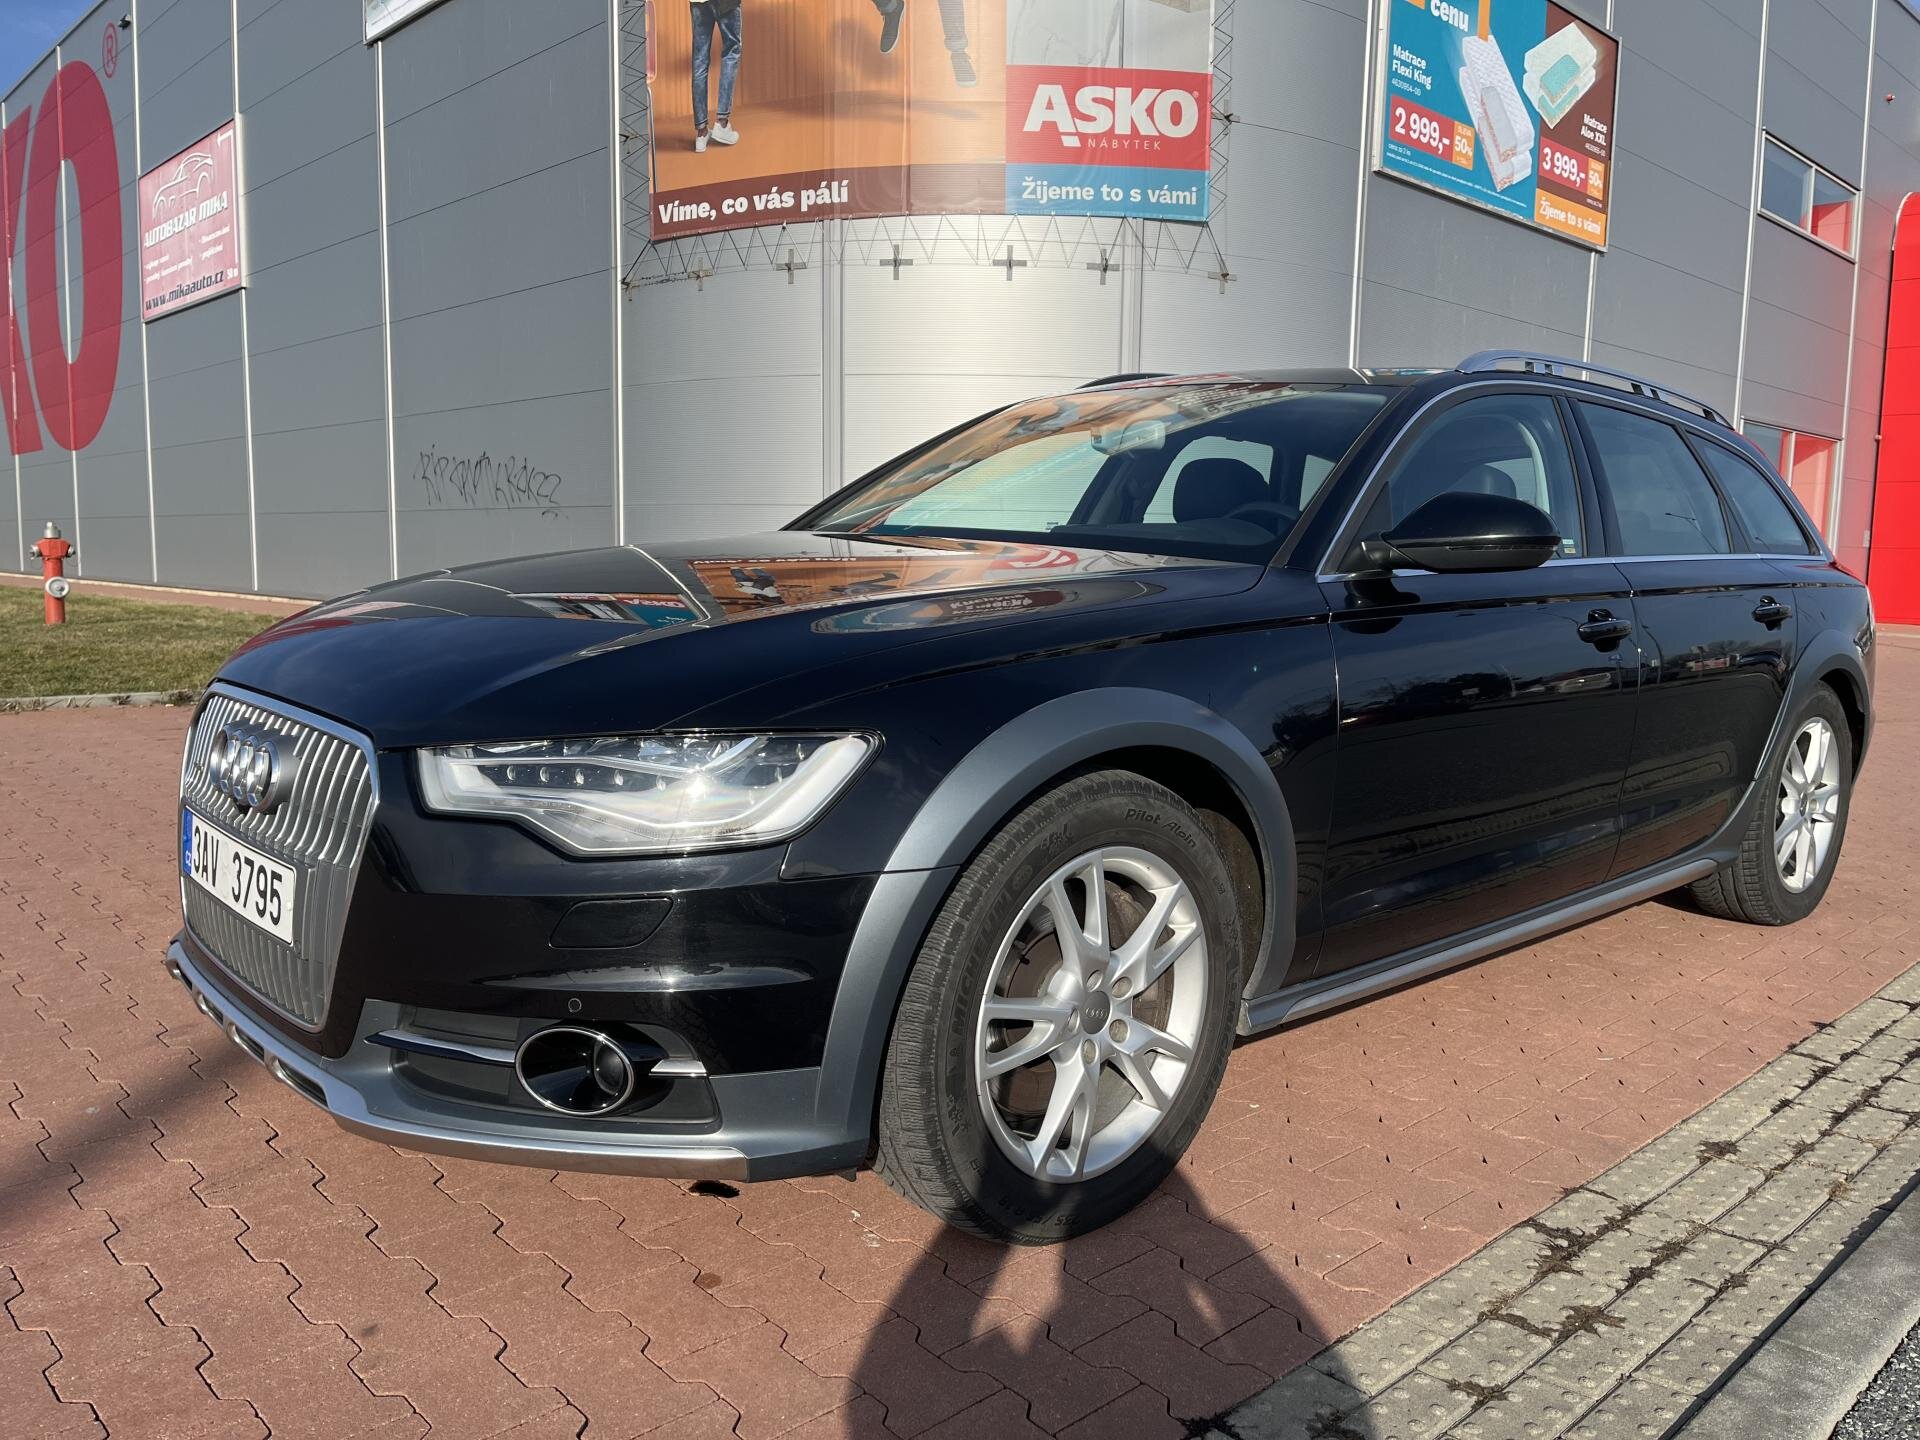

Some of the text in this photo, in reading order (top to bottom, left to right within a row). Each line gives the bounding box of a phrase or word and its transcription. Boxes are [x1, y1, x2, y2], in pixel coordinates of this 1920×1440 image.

[1430, 0, 1469, 32] cenu
[1393, 44, 1427, 69] Matrace
[1392, 60, 1432, 91] Flexi King
[1023, 84, 1199, 147] ASKO
[1395, 106, 1450, 154] 2 999,-
[1584, 114, 1607, 133] Matrace
[1088, 137, 1161, 151] NÁBYTEK
[1455, 135, 1472, 157] 50%
[1542, 146, 1551, 171] 3
[1553, 151, 1585, 187] 999,-
[658, 179, 850, 225] Víme, co vás pálí
[1022, 176, 1197, 205] Žijeme to s vámi
[143, 206, 197, 249] AUTOBAZAR
[198, 190, 229, 223] MIKA
[1539, 197, 1566, 220] Žijeme
[1567, 211, 1577, 226] to
[144, 270, 225, 312] www.mikaauto.cz
[1124, 808, 1162, 825] Pilot
[193, 825, 283, 927] 3AV 3795
